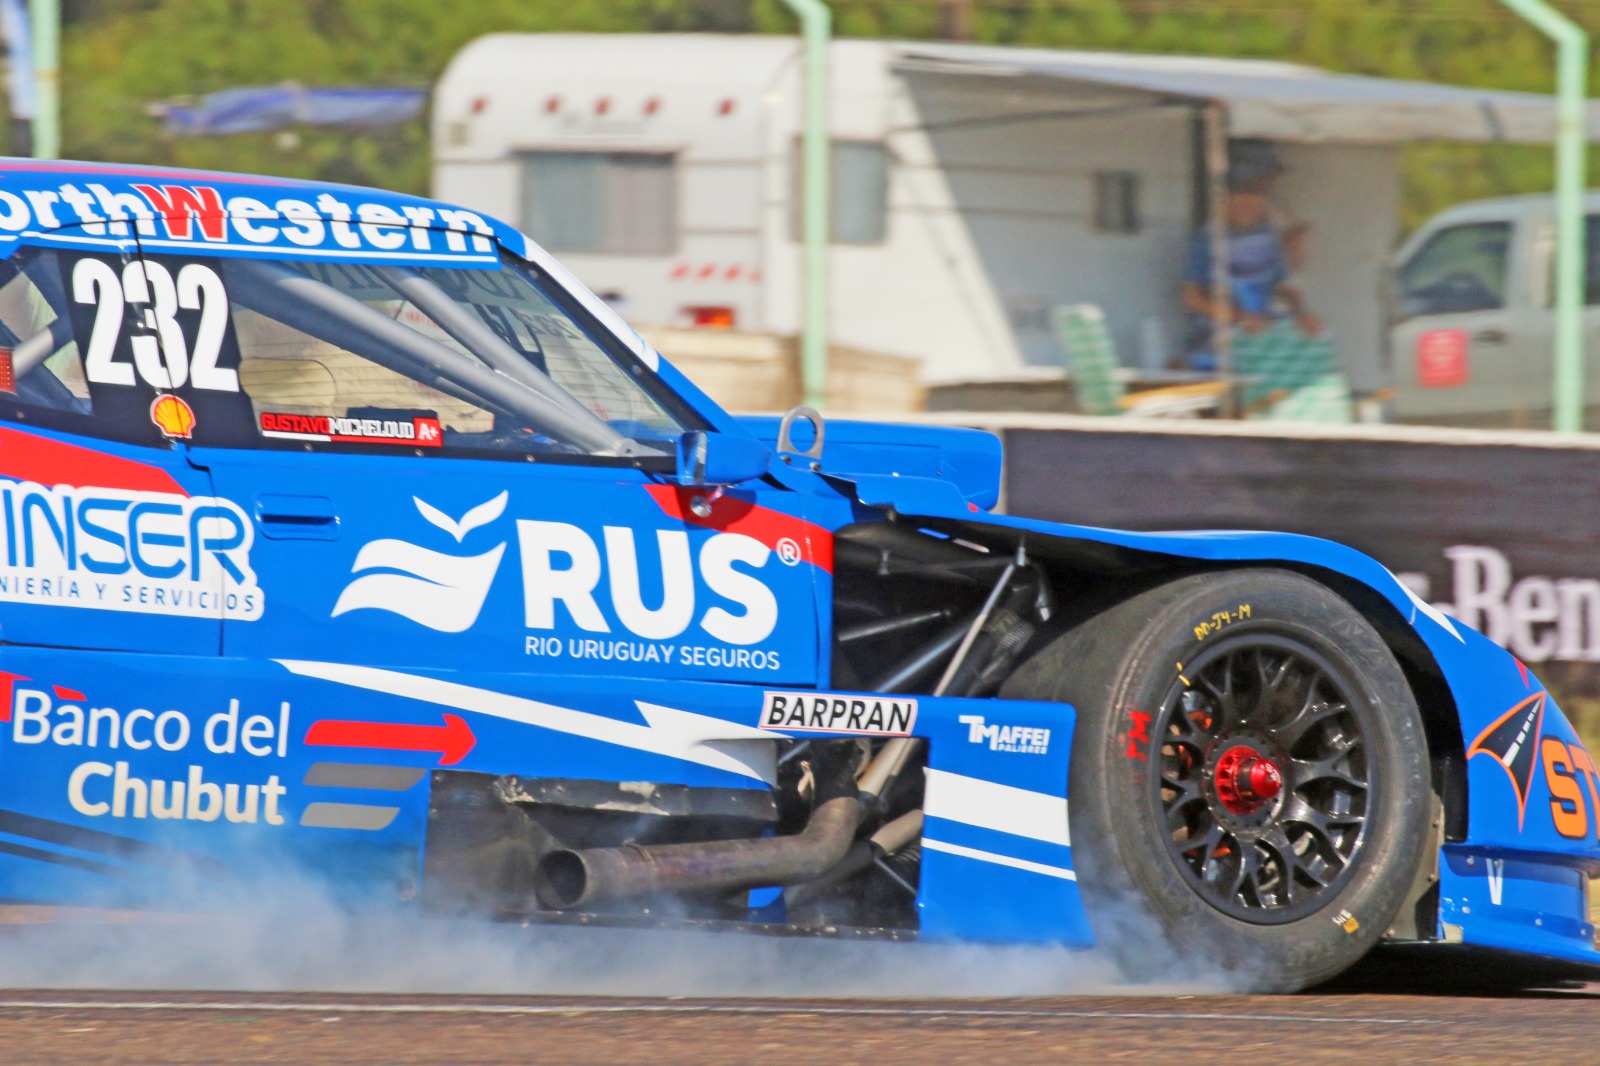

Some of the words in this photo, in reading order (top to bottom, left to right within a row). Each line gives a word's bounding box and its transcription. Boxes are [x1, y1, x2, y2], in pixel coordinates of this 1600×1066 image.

[72, 257, 239, 392] 232
[96, 583, 106, 600] Y
[123, 585, 254, 612] SERVICIOS
[525, 636, 562, 657] RIO
[569, 639, 674, 664] URUGUAY
[680, 646, 780, 671] SEGUROS
[13, 689, 190, 751] Banco
[204, 698, 291, 757] del
[768, 696, 912, 732] BARPRAN
[67, 760, 287, 825] Chubut
